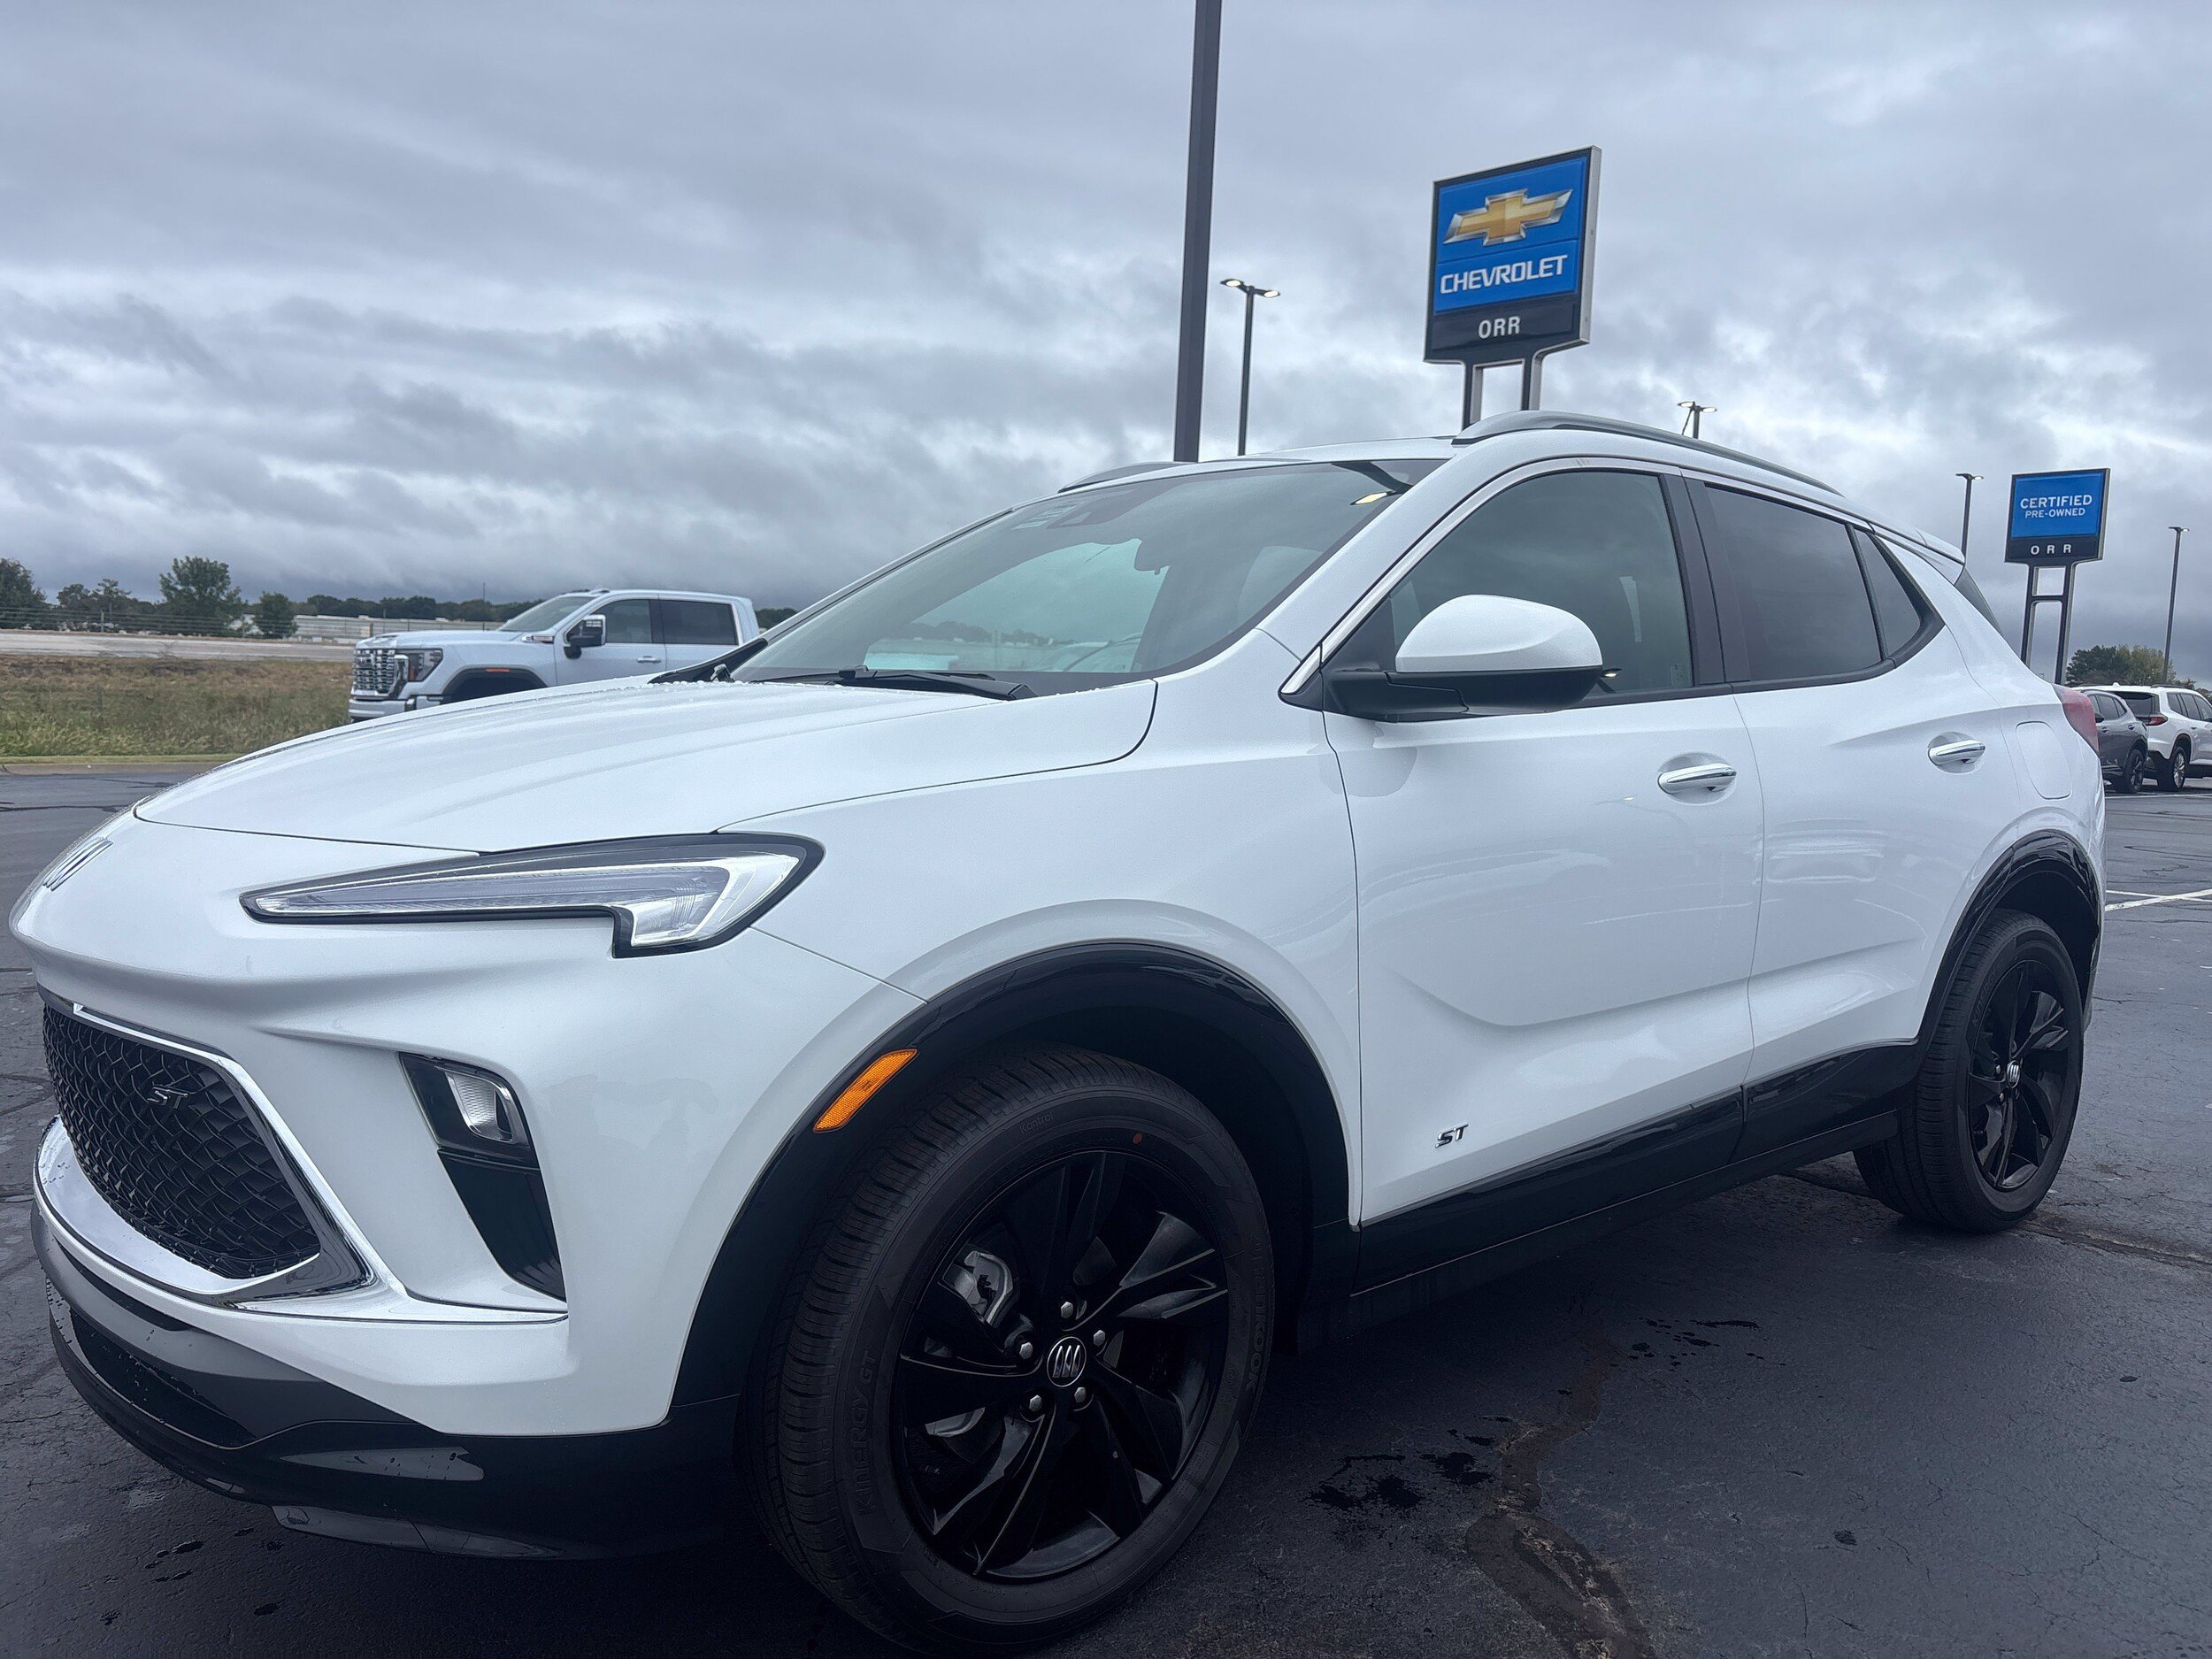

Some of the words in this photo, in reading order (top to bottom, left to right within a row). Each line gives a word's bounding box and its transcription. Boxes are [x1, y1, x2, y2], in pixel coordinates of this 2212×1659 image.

[1440, 254, 1568, 295] CHEVROLET
[1478, 315, 1521, 340] ORR
[2020, 494, 2093, 510] CERTIFIED
[2024, 507, 2085, 518] PRE-OWNED
[2030, 543, 2072, 556] ORR
[147, 1087, 188, 1110] ST
[1435, 1124, 1469, 1148] ST
